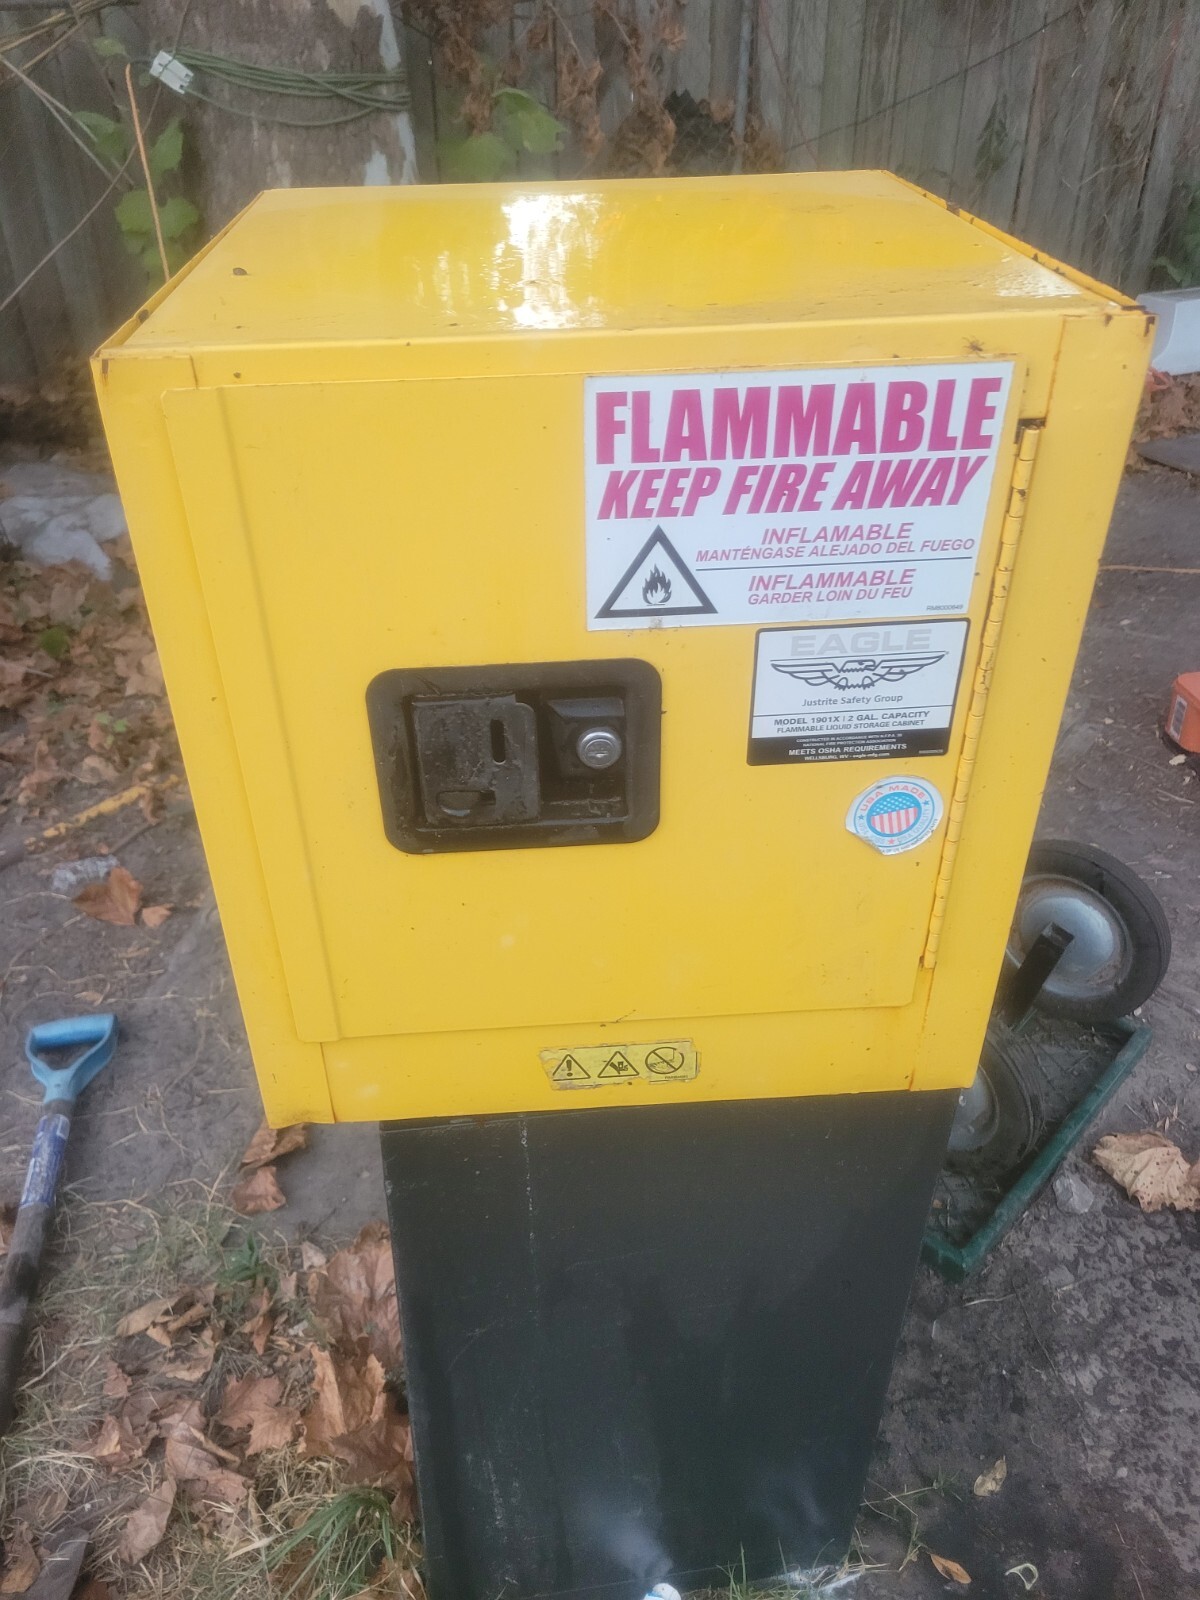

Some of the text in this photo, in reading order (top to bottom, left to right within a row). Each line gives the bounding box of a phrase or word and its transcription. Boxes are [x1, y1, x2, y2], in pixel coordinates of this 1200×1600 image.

[596, 377, 1003, 464] FLAMMABLE
[597, 456, 988, 520] KEEP FIRE AWAY
[761, 522, 914, 545] INFLAMABLE
[696, 538, 975, 562] MANTÉNGASE ALEJADO DEL FUEGO
[748, 569, 917, 591] INFLAMMABLE
[748, 587, 913, 605] GARDER LOIN DU FEU
[790, 629, 932, 656] EAGLE
[801, 695, 903, 707] Justrite Safety Group
[774, 718, 808, 726] MODEL
[811, 716, 840, 724] 1901X
[856, 714, 878, 722] GAL.
[881, 711, 930, 720] CAPACITY
[777, 719, 925, 733] FLAMMABLE LIQUID STORAGE CABINET
[843, 743, 907, 753] REQUIREMENTS
[860, 785, 925, 811] USA MADE
